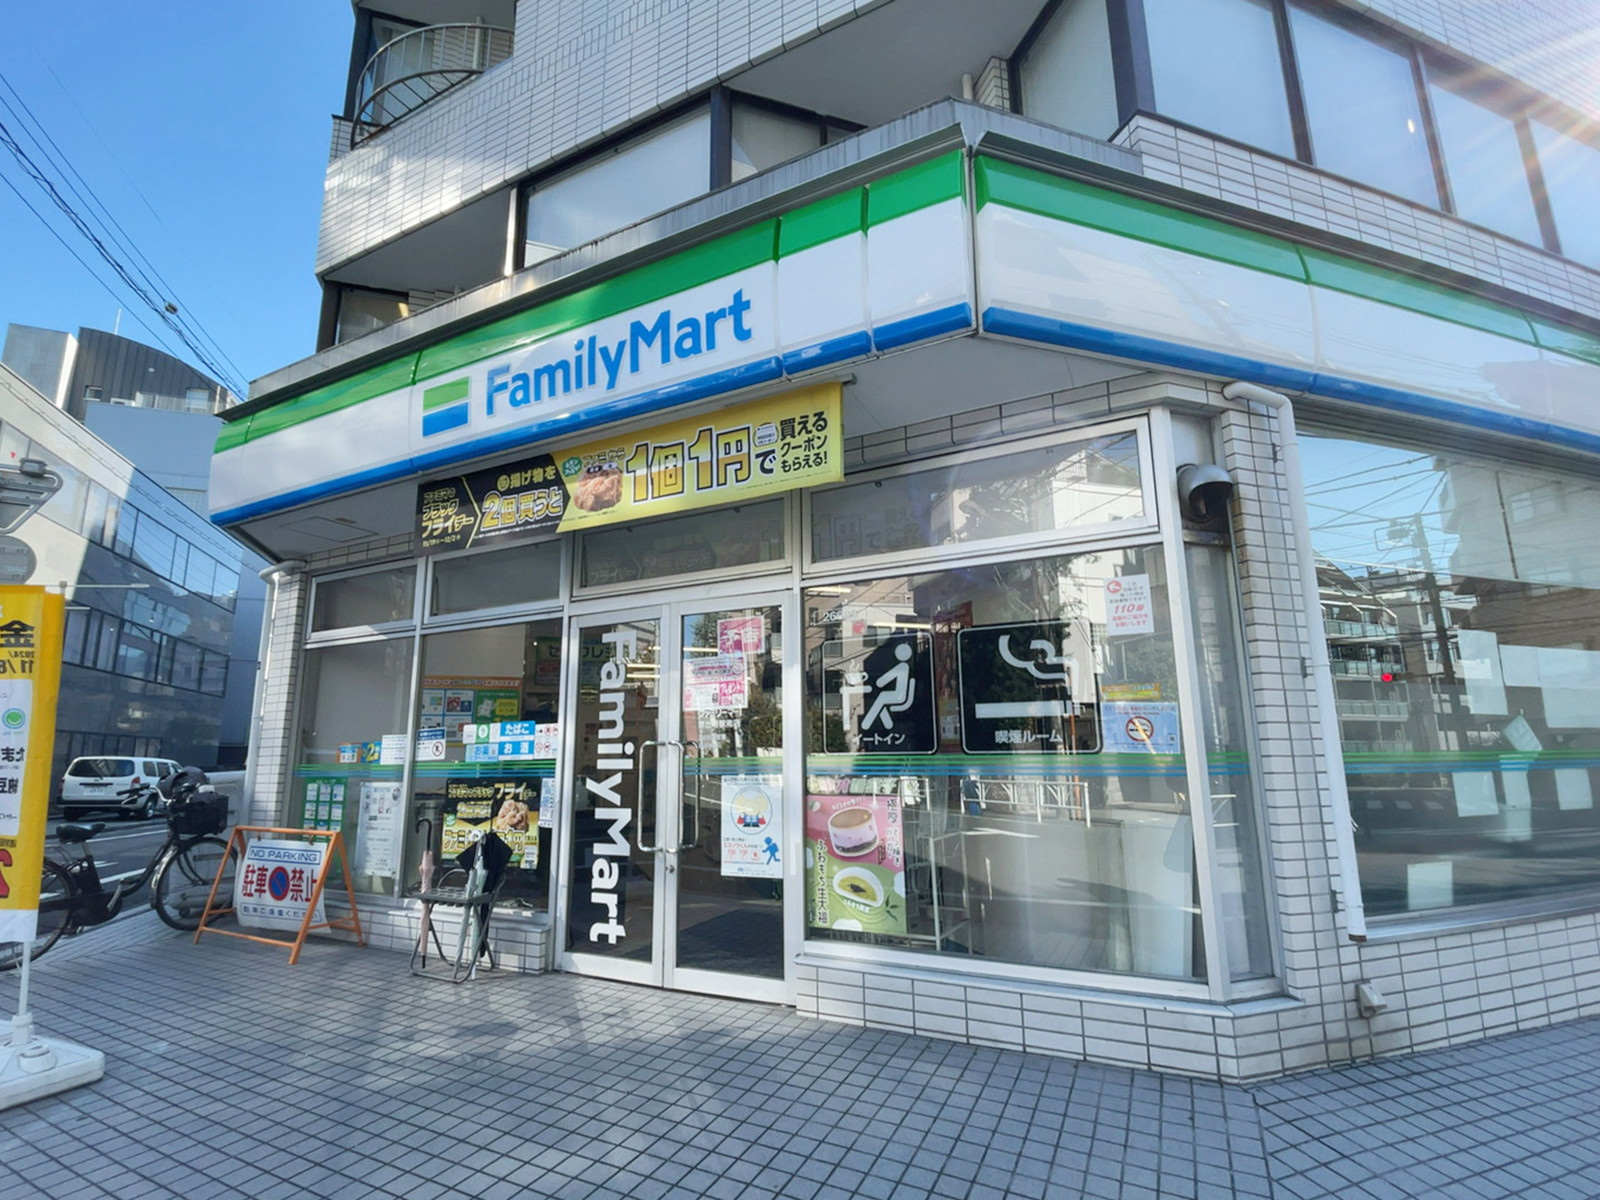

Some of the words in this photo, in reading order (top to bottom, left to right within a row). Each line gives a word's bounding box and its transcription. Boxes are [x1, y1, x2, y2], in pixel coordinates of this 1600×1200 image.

[486, 288, 752, 416] FamilyMart
[780, 411, 828, 441] 買える
[781, 435, 828, 458] クーポン
[480, 486, 564, 531] 2個買うと
[422, 513, 475, 539] フライデー
[504, 723, 530, 735] たばこ
[852, 732, 906, 745] イートイン
[994, 730, 1063, 744] 喫煙ルーム
[586, 629, 637, 945] FamilyMart
[250, 848, 265, 858] NO
[267, 849, 318, 862] PARKING
[243, 863, 268, 899] 駐車
[290, 866, 319, 903] 禁止
[816, 839, 829, 925] ふわもち生大福
